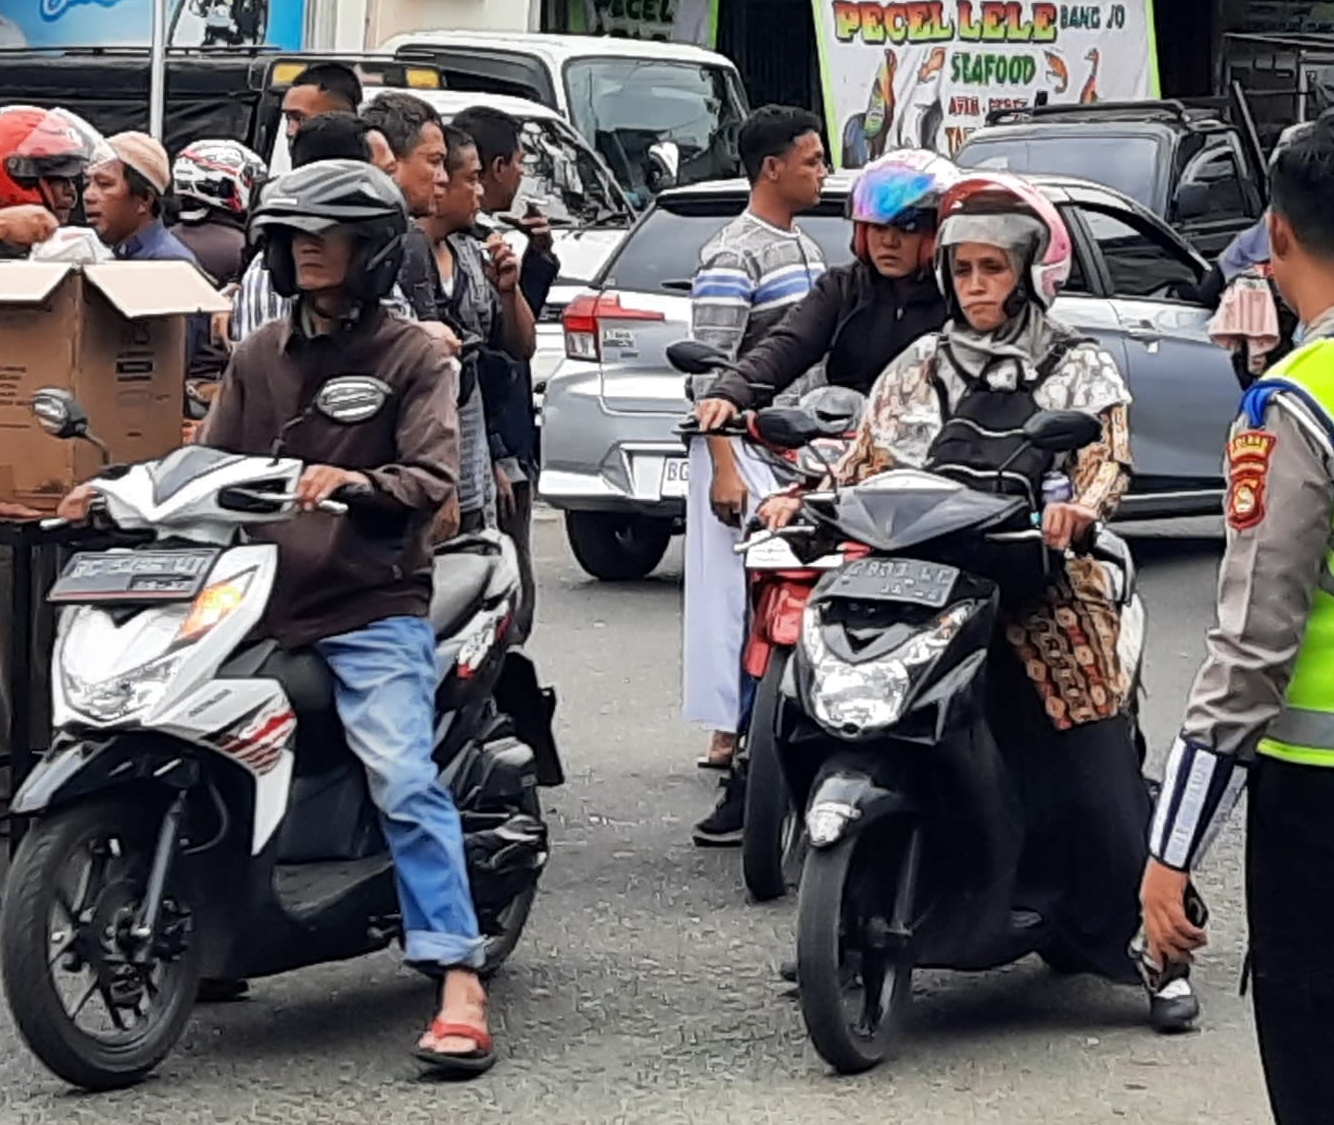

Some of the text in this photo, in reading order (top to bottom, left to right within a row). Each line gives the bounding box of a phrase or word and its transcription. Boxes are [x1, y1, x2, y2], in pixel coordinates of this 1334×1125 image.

[832, 0, 953, 44] PECEL
[955, 0, 1058, 43] LELE
[1059, 4, 1101, 30] BANG
[950, 51, 1036, 86] SEAFOOD
